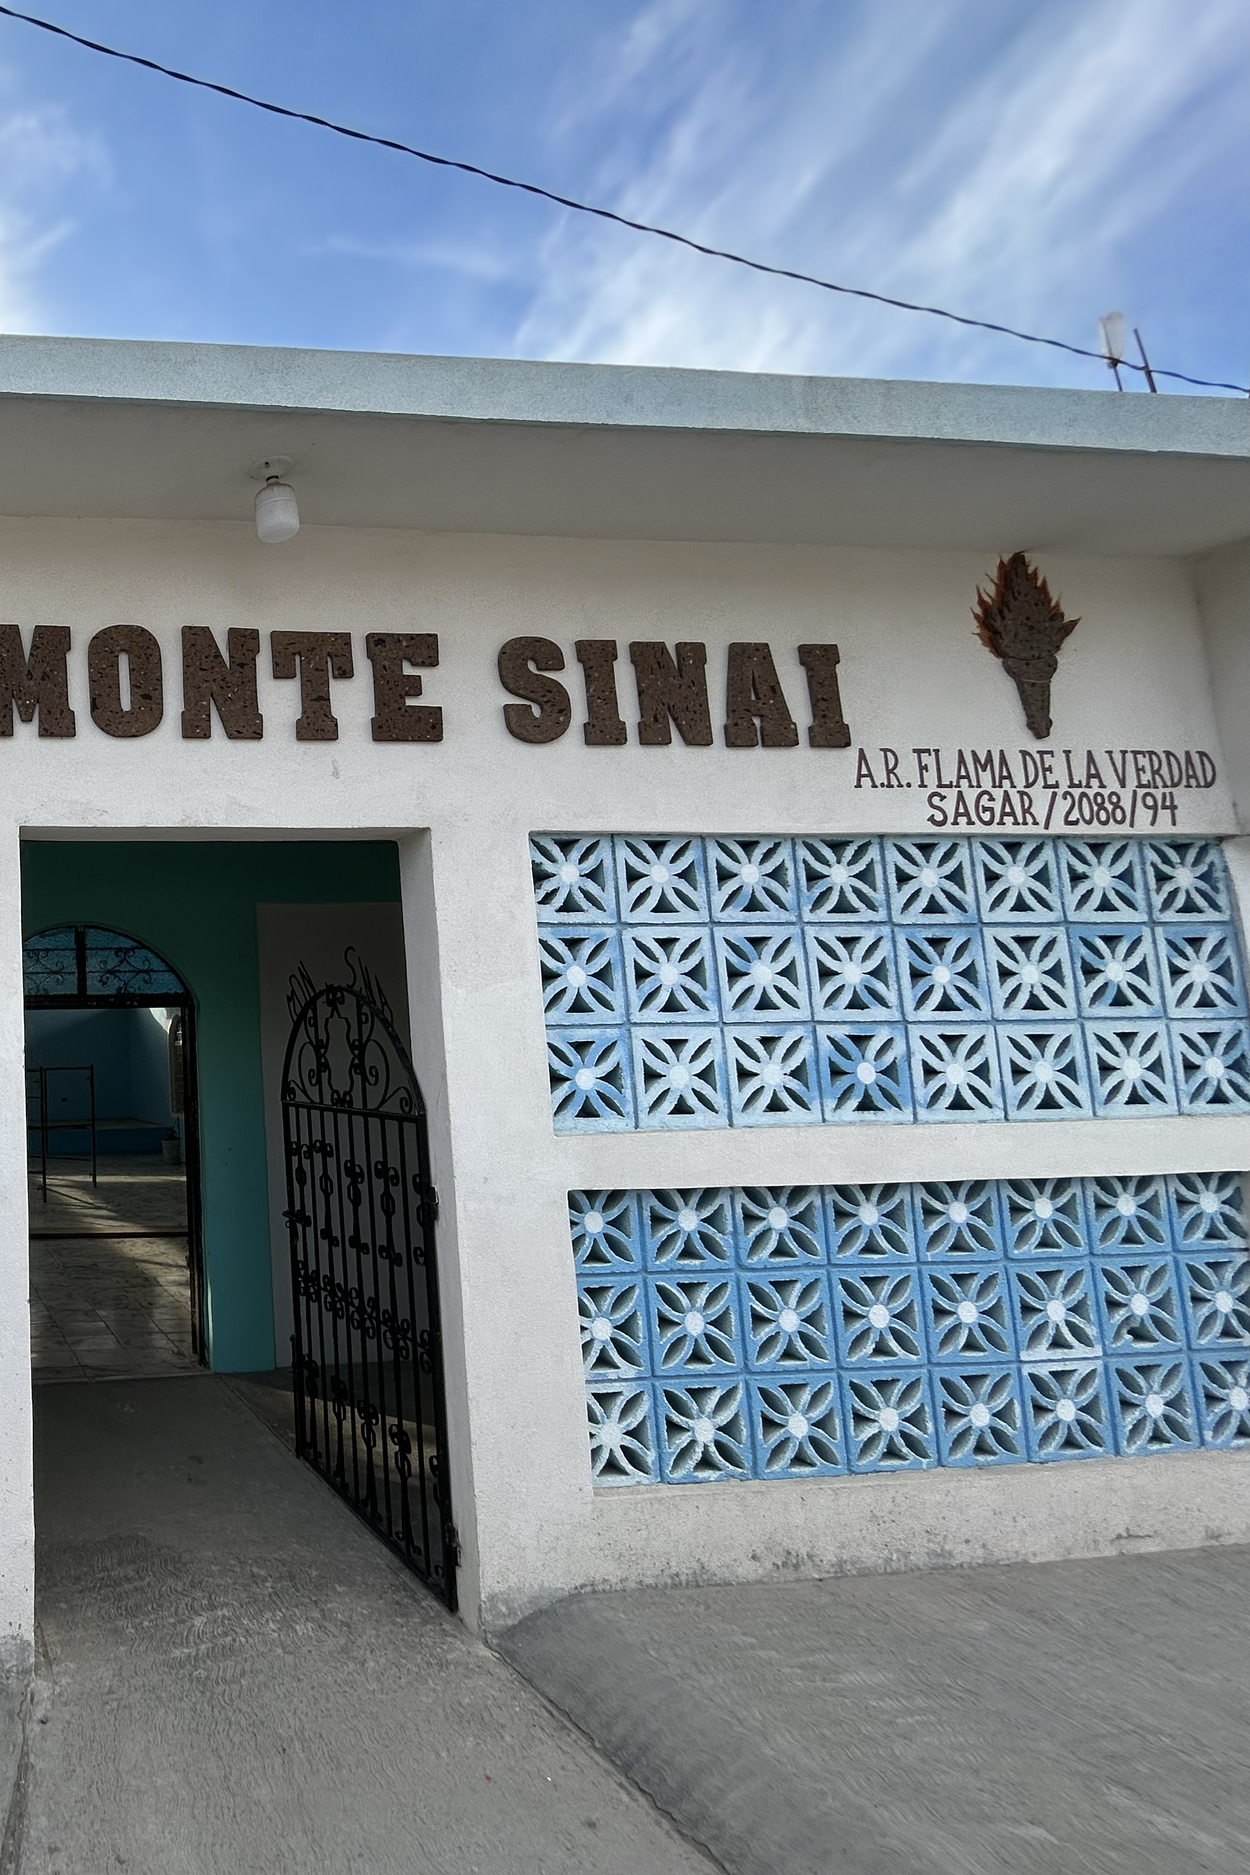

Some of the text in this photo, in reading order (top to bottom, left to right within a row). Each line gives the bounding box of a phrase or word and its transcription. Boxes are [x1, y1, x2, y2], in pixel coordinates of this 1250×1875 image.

[497, 635, 852, 749] SINAI
[854, 747, 1217, 790] A.R. FLAMA DE LA VERDAD
[926, 790, 1178, 831] SAGAR/2088/94
